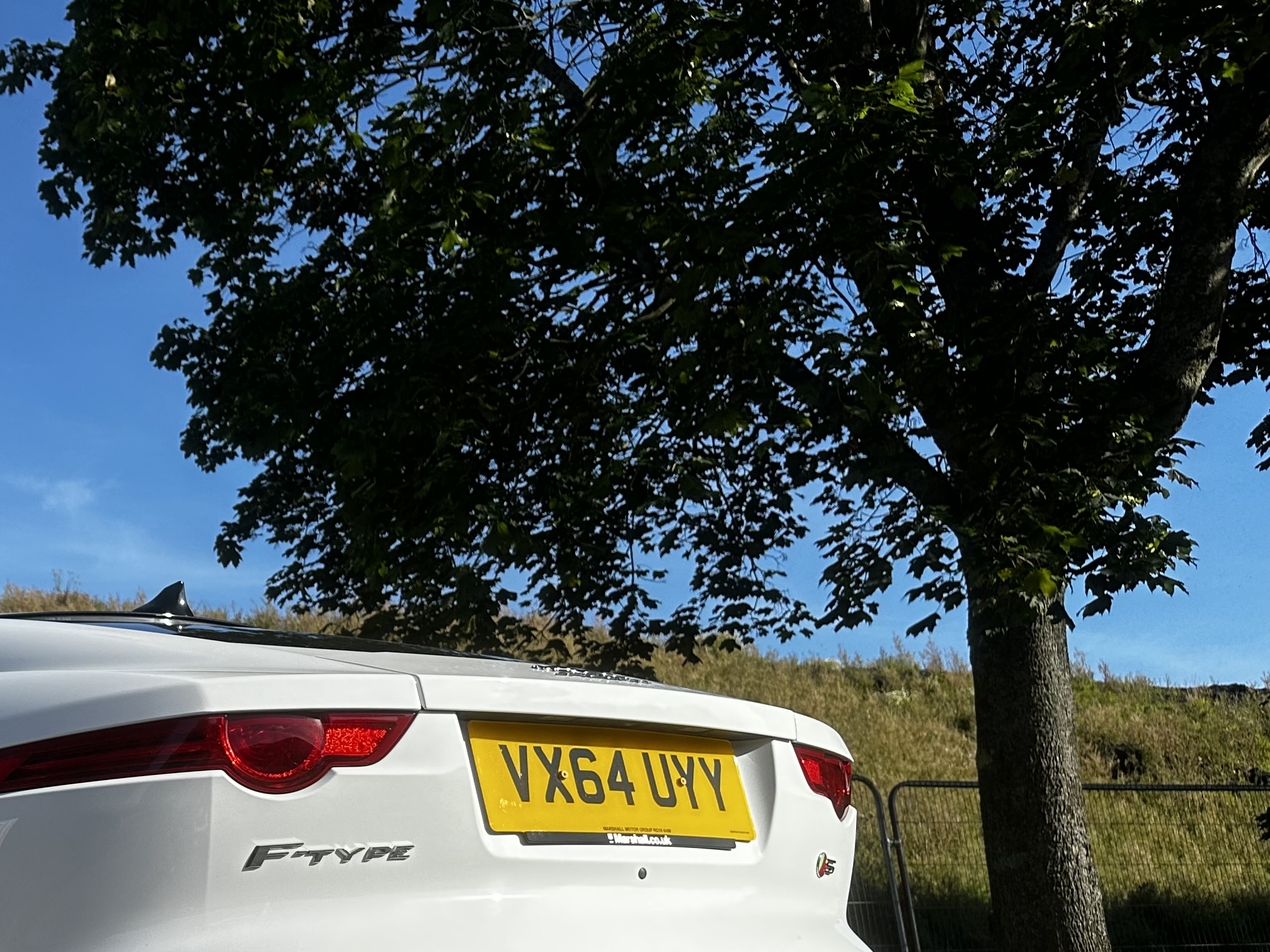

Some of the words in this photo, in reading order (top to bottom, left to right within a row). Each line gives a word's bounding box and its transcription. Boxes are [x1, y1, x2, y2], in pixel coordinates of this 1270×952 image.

[498, 744, 635, 806] VX64
[641, 752, 726, 812] UYY
[241, 841, 415, 872] F-TYPE
